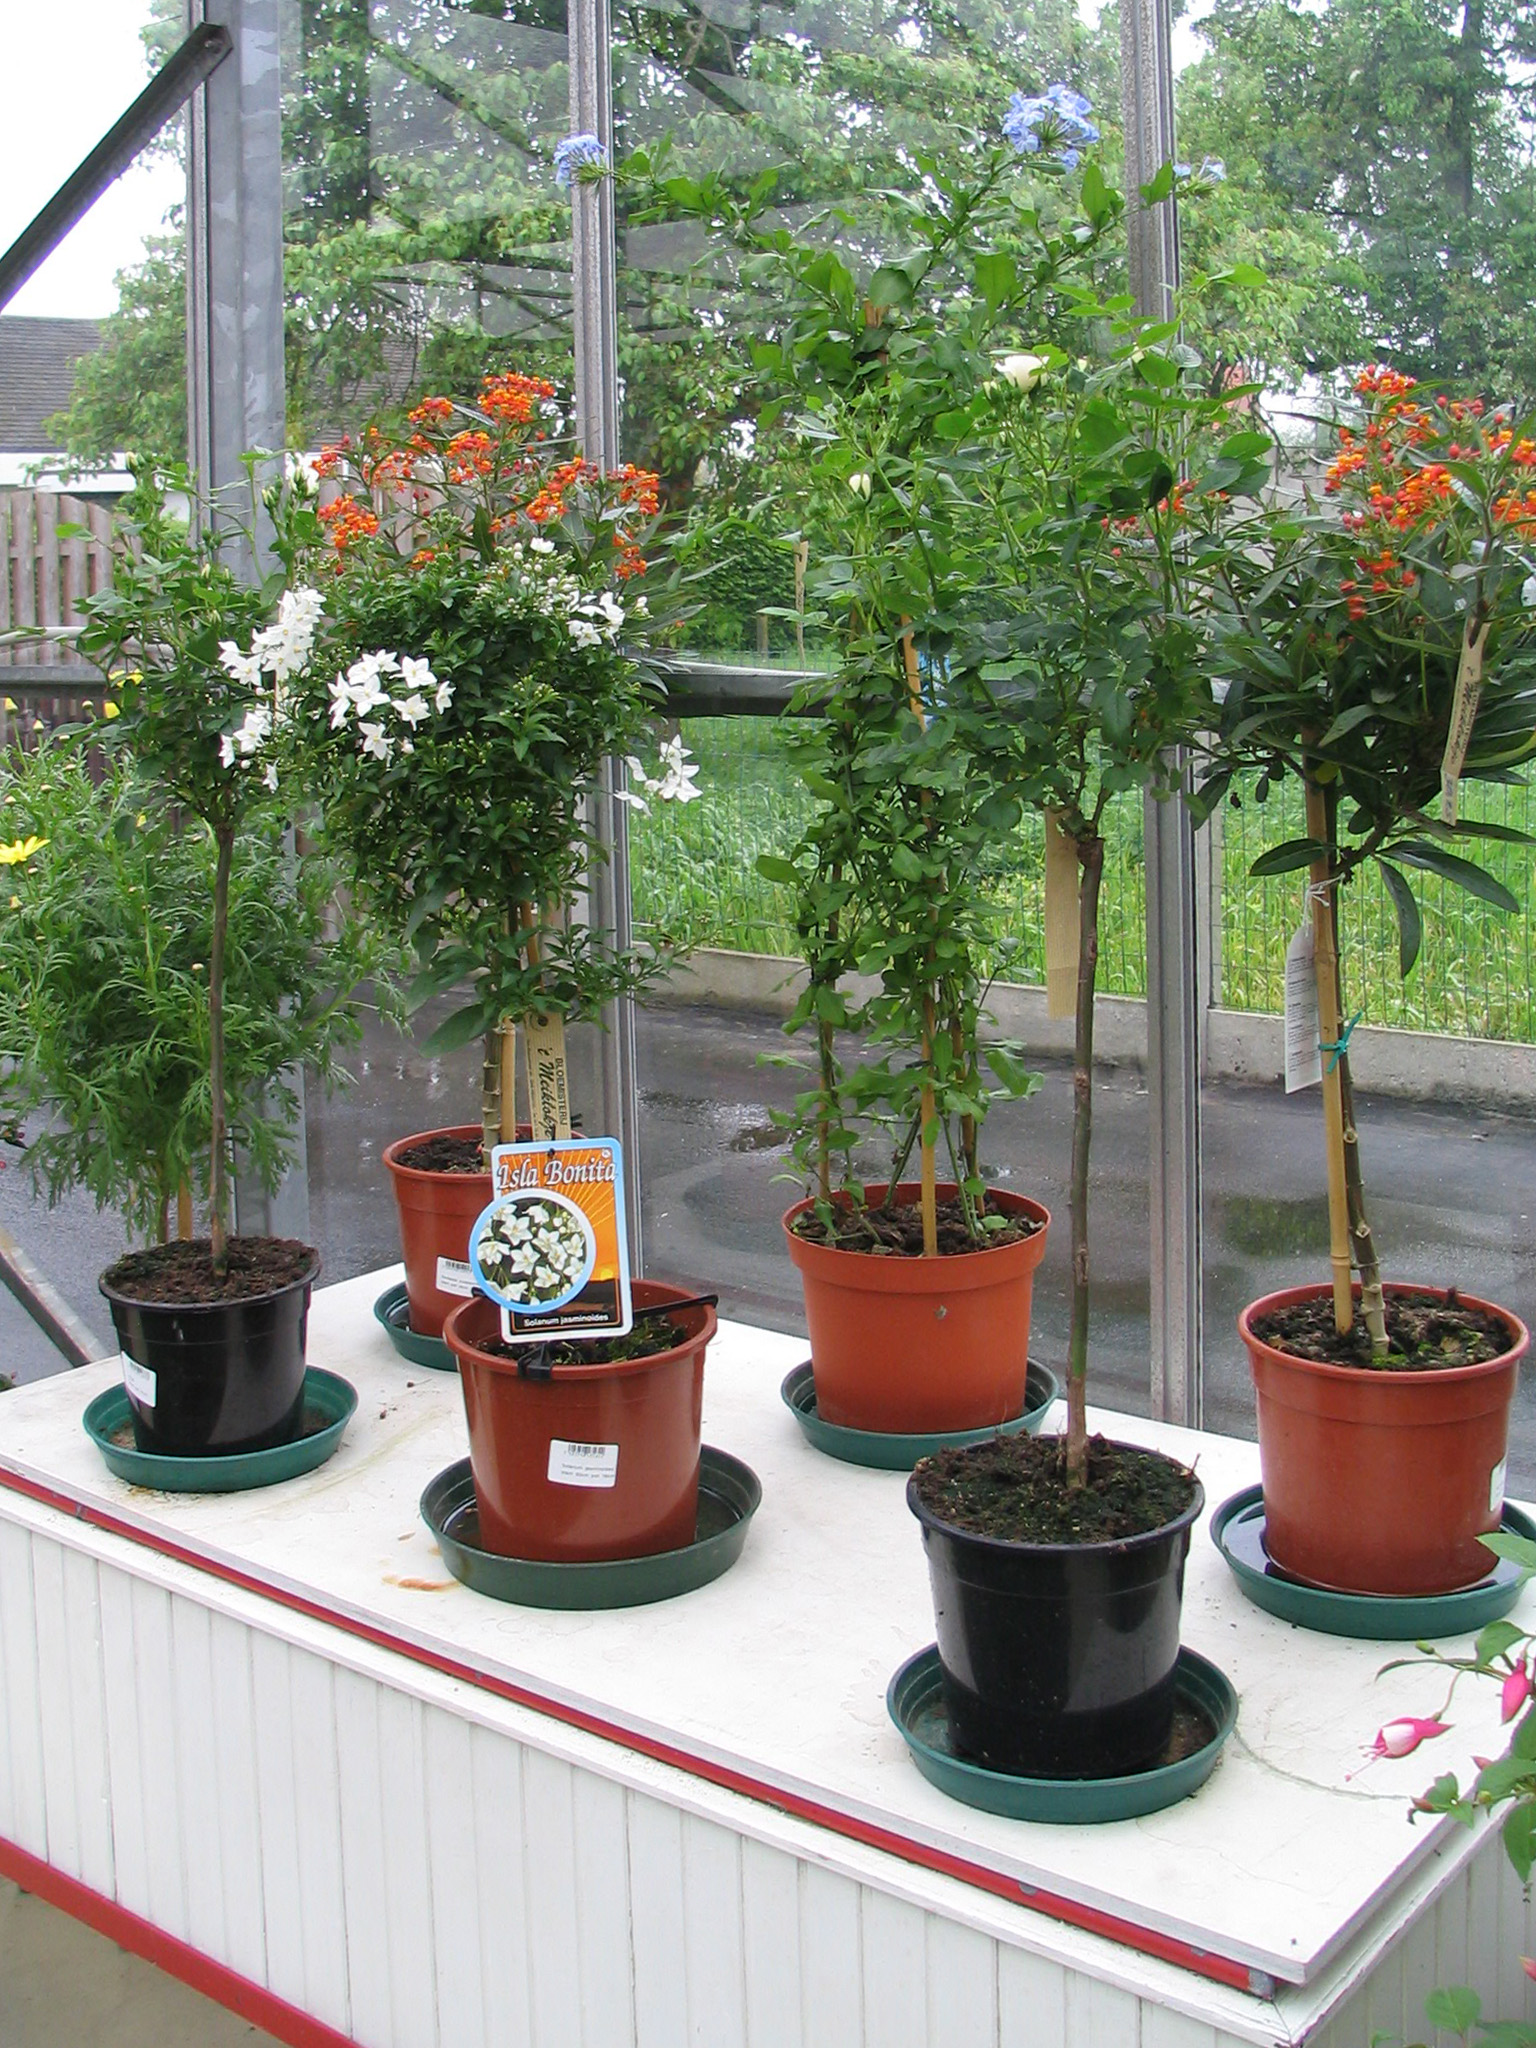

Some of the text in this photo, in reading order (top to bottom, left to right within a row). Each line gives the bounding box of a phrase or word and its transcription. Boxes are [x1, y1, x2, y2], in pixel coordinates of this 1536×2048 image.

[496, 1156, 617, 1190] Isla Bonita
[523, 1313, 609, 1327] Solanum jasminoides
